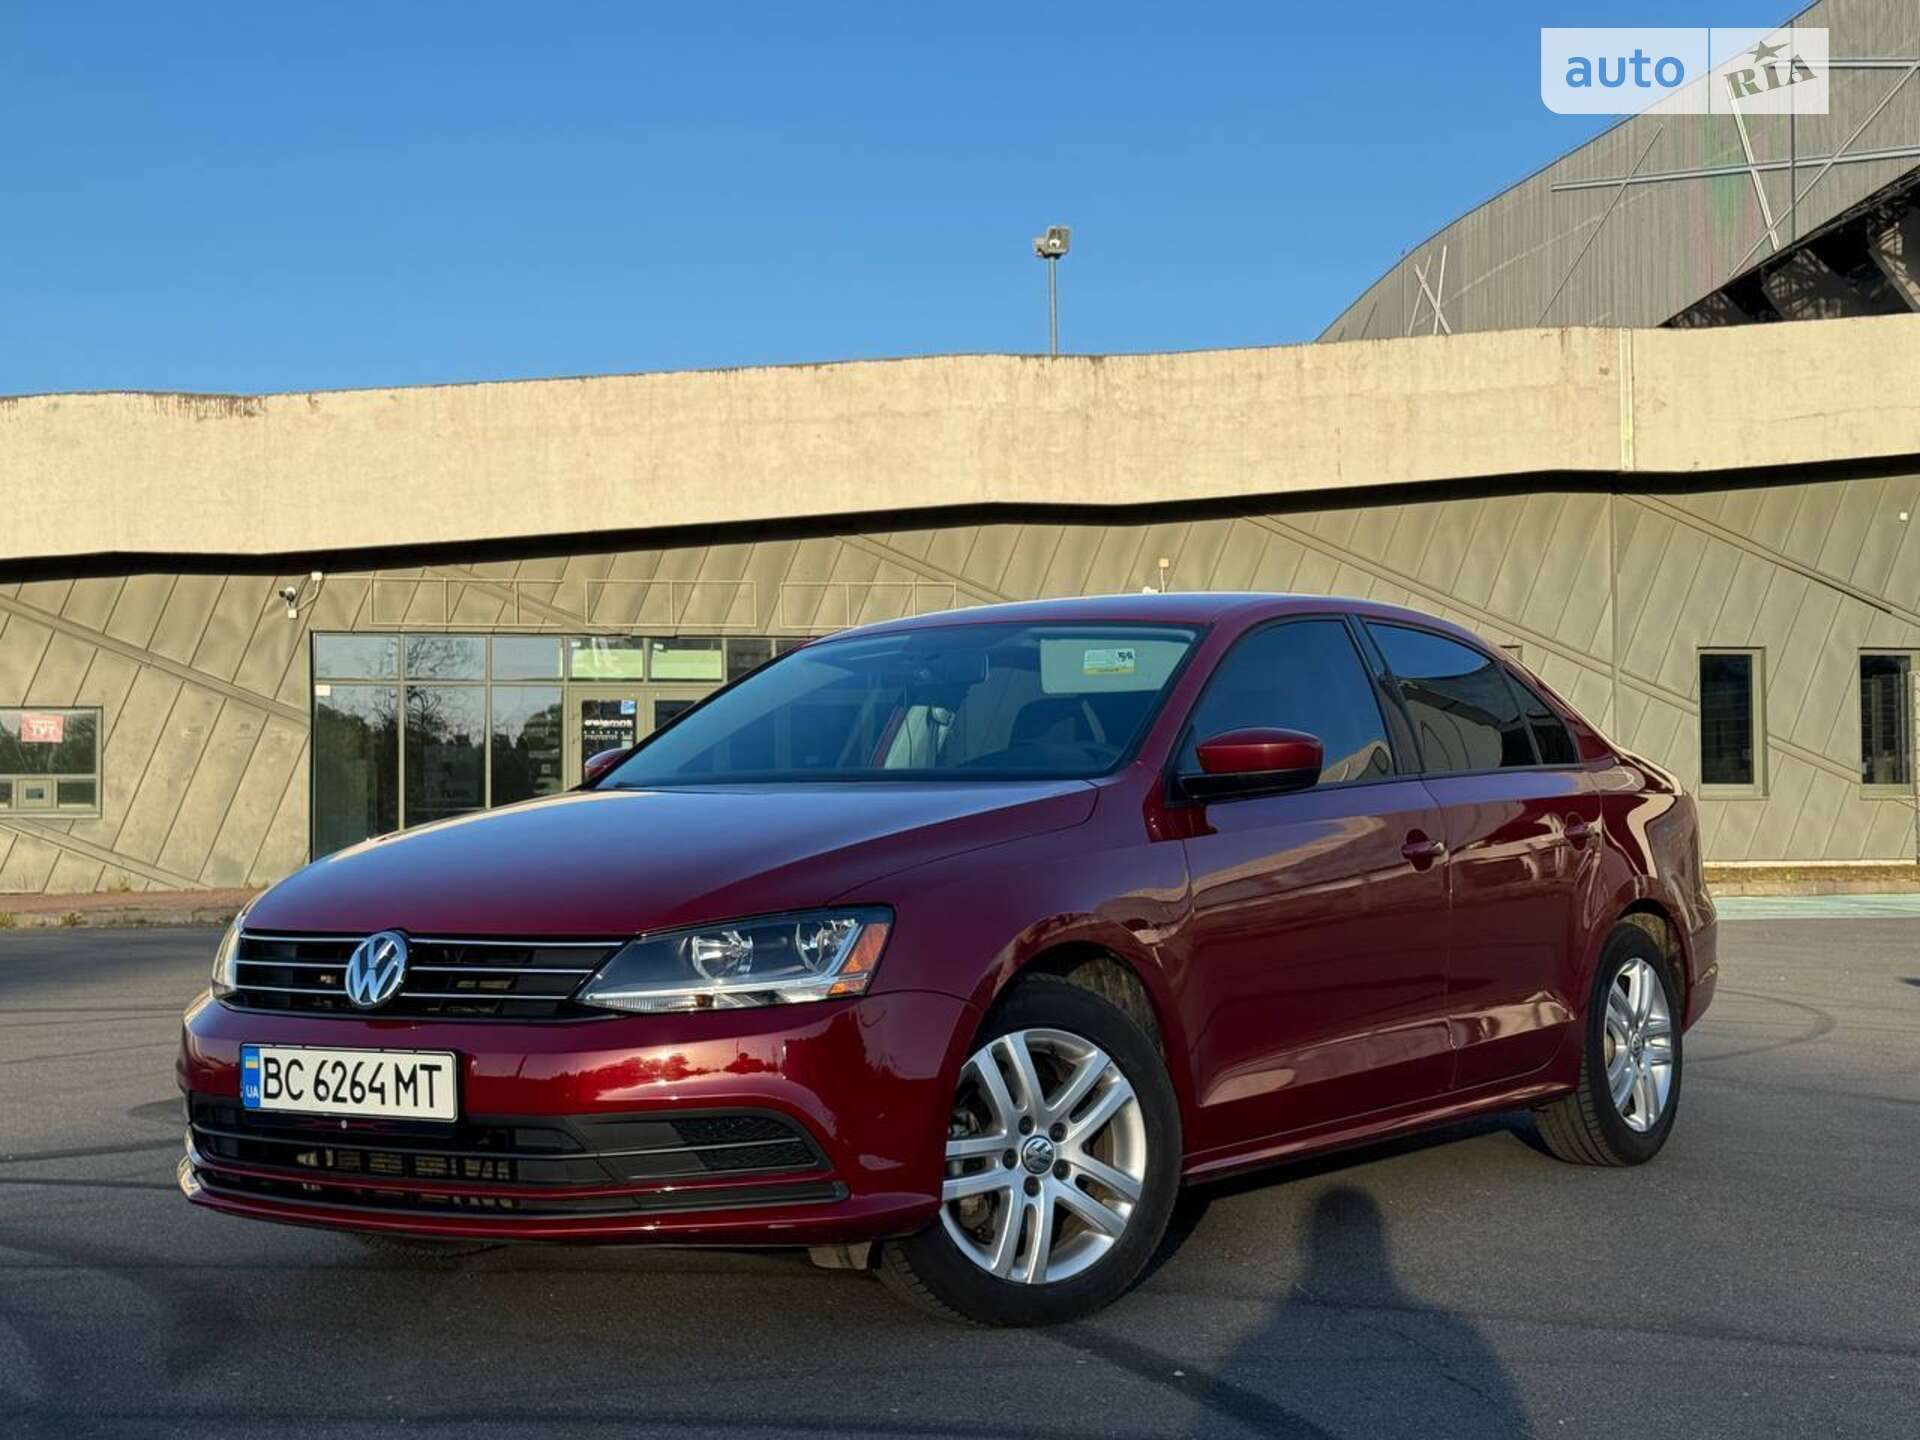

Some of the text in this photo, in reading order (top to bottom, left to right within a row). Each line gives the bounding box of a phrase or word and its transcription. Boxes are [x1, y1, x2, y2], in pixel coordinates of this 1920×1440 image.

[245, 1085, 259, 1099] UA
[263, 1056, 442, 1109] BC 6264 MT
